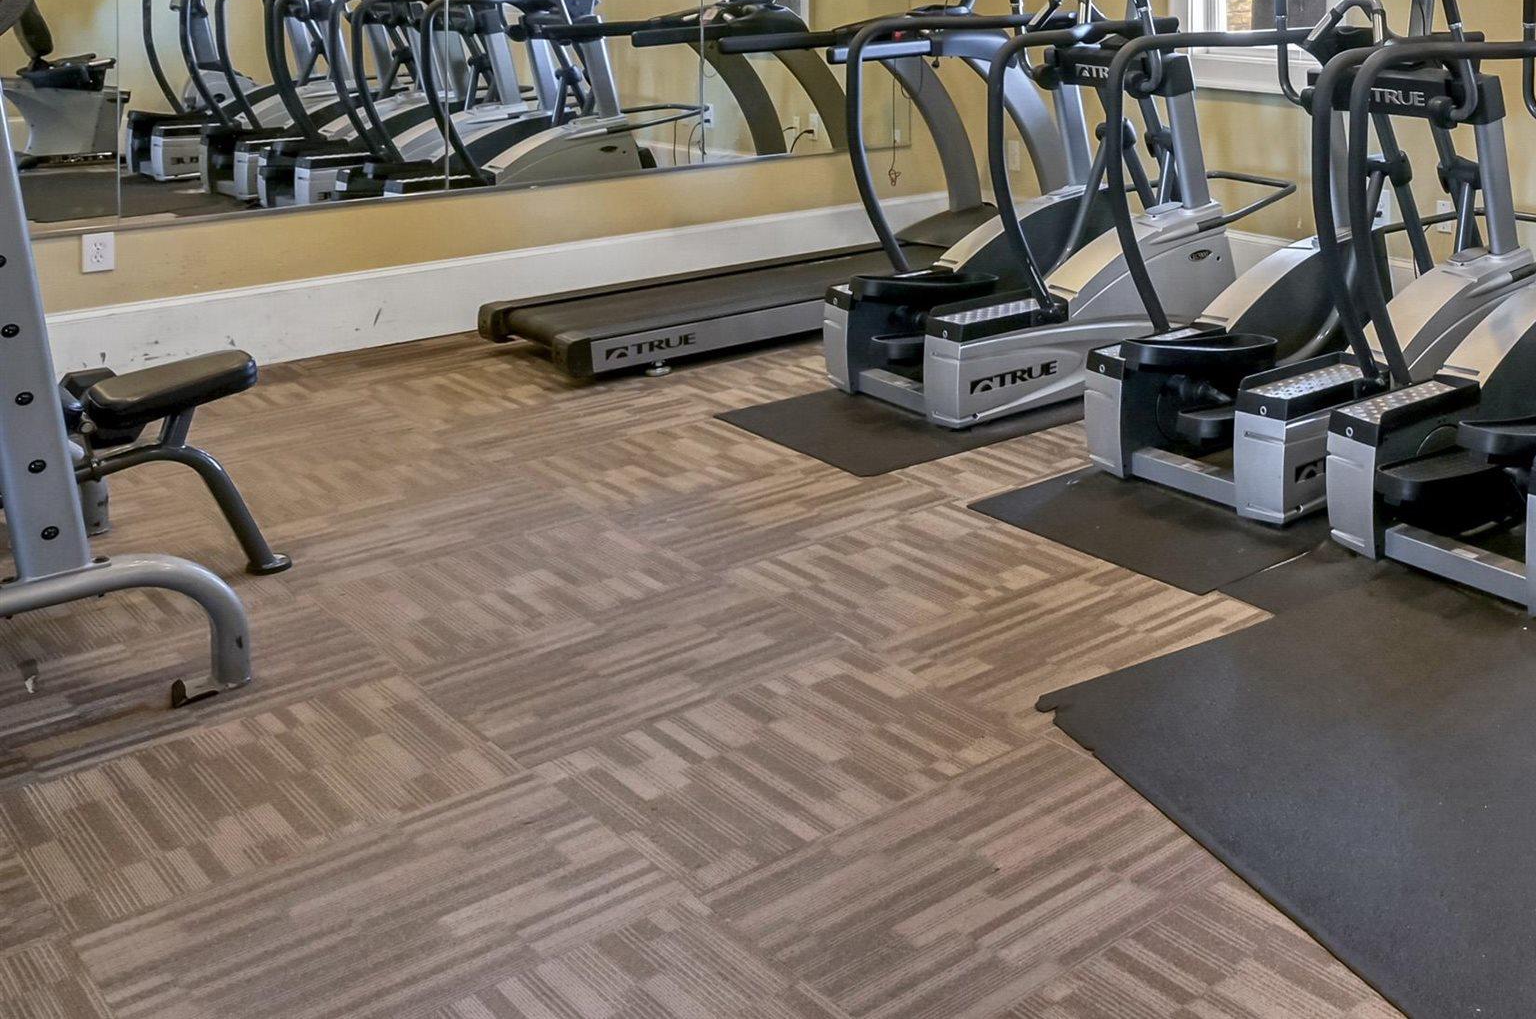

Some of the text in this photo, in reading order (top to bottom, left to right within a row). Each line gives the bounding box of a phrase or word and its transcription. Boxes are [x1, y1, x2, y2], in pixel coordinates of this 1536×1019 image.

[1091, 65, 1109, 79] TR
[1370, 87, 1426, 107] TRUE
[631, 332, 696, 355] TRUE
[996, 360, 1058, 388] TRUE
